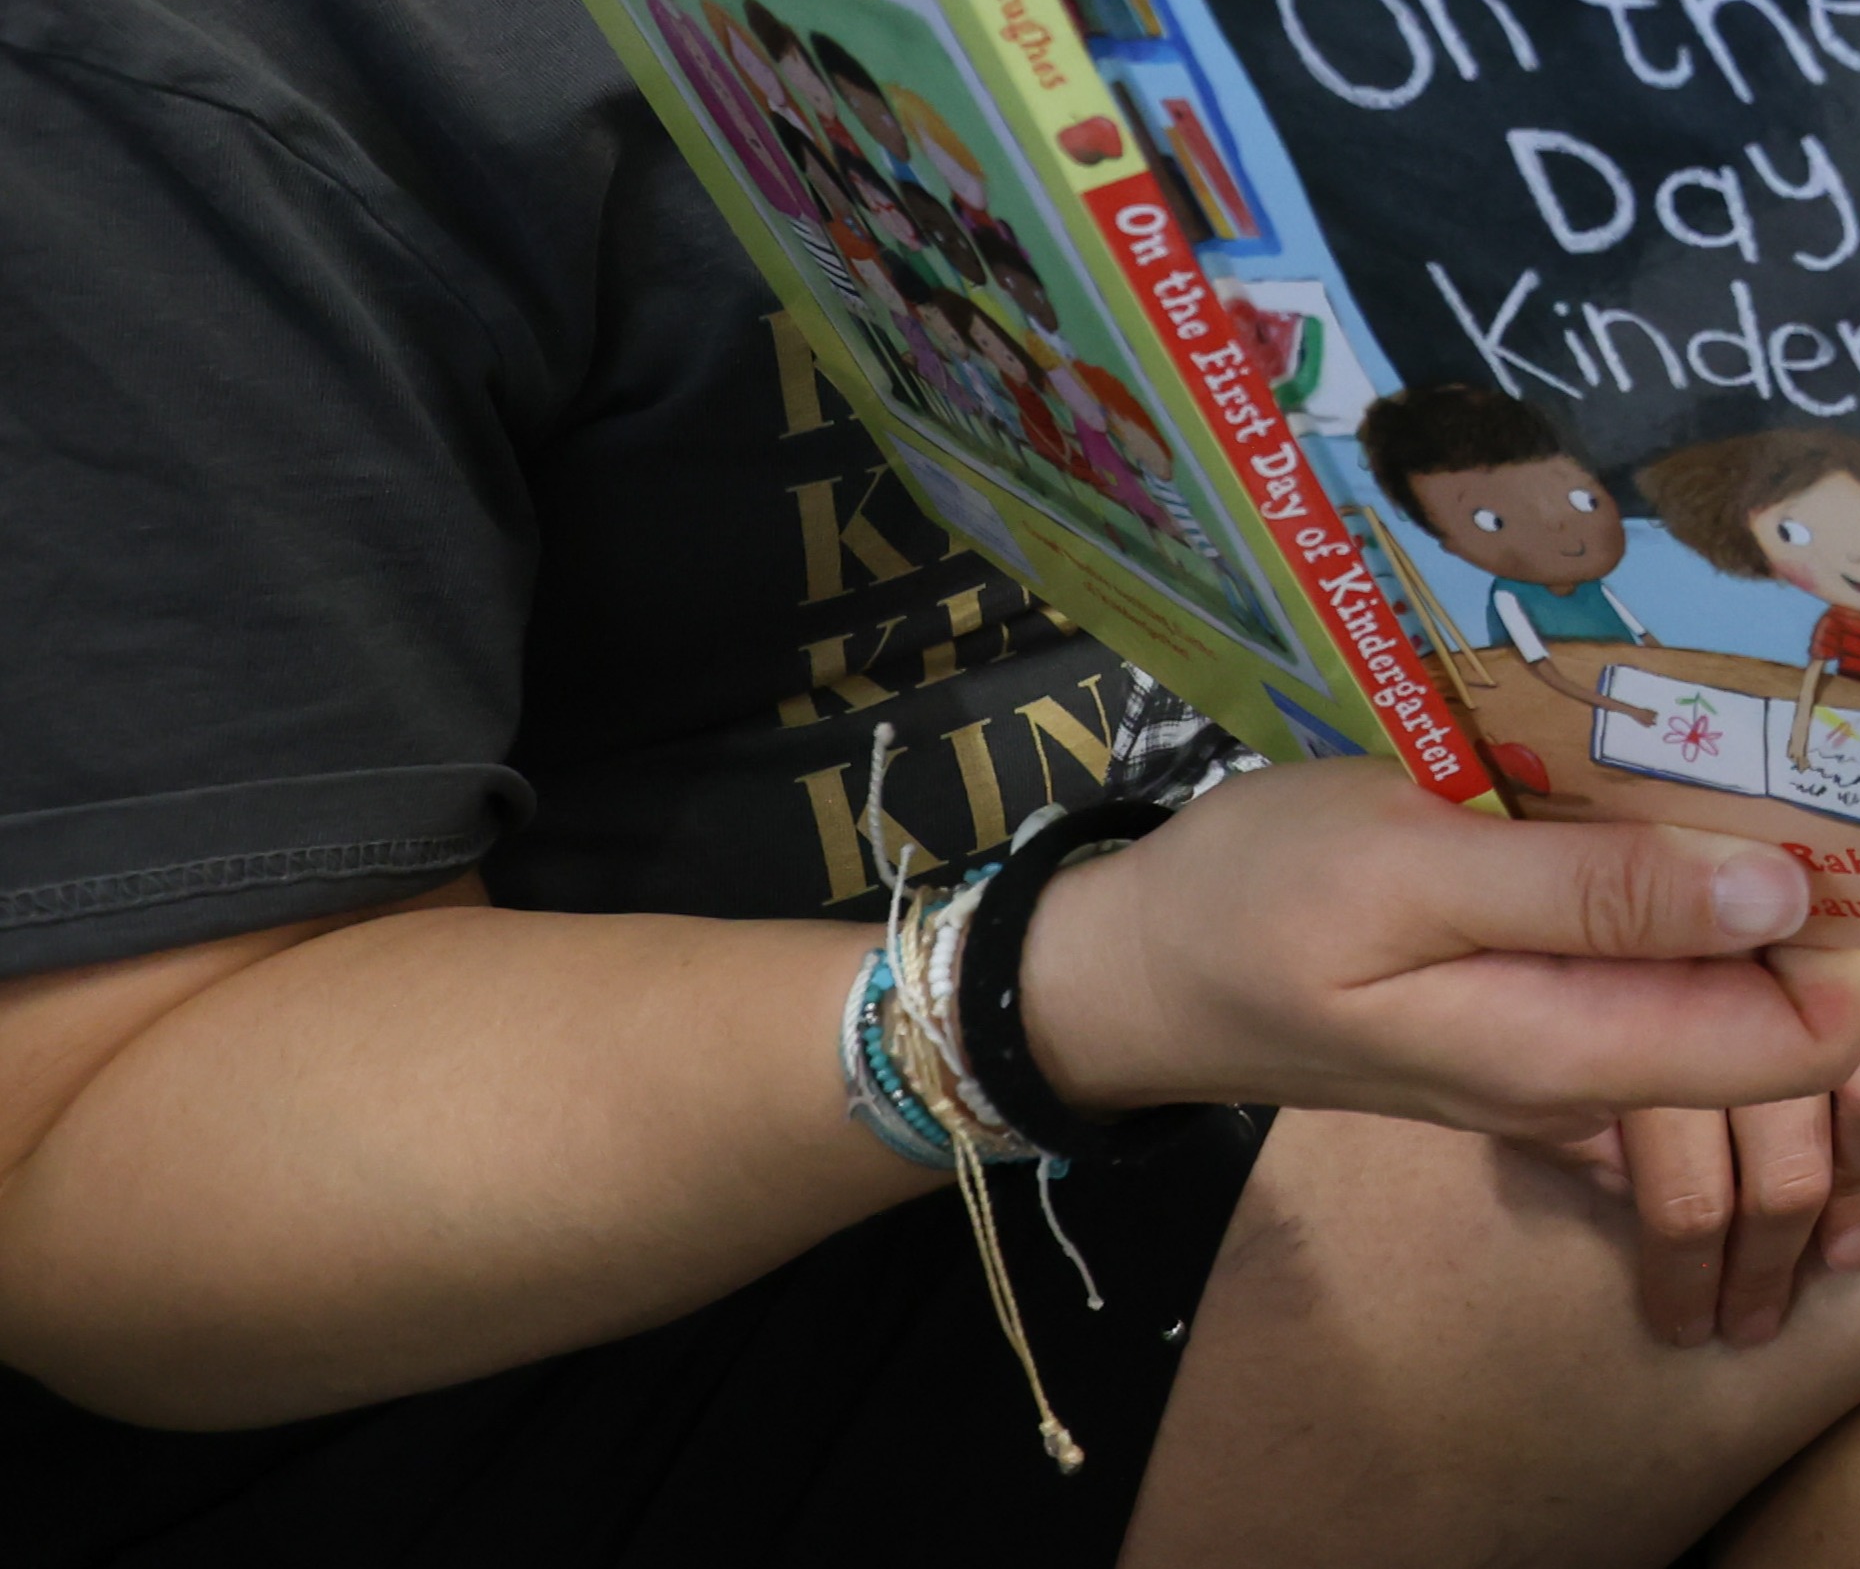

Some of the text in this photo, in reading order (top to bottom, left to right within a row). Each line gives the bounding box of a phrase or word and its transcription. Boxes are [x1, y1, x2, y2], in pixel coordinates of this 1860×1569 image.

[1506, 128, 1860, 271] Day
[1115, 202, 1462, 785] On the First Day of Kindergarten
